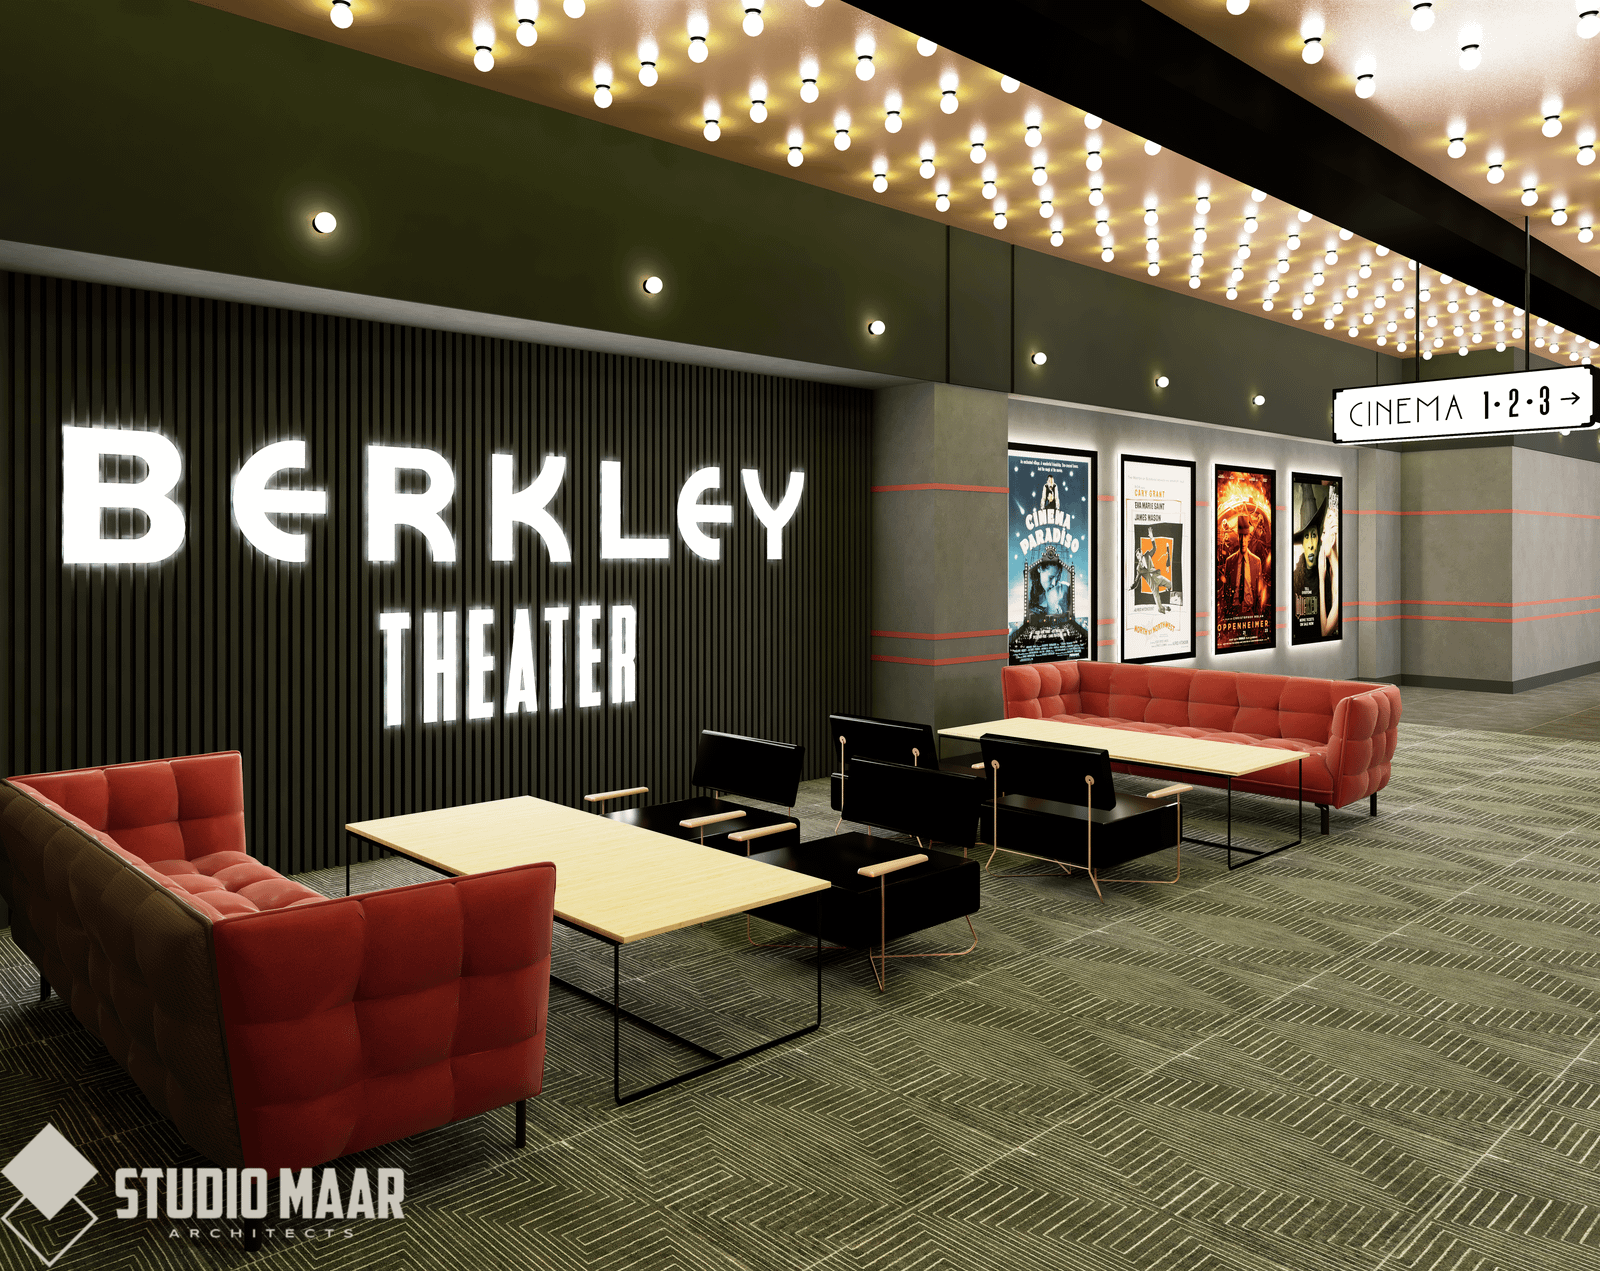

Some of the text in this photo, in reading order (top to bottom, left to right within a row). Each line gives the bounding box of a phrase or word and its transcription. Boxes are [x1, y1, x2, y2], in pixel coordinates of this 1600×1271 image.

[1350, 394, 1463, 427] CINEMA
[63, 425, 805, 564] BERKLEY
[1149, 490, 1165, 498] GRANT
[1025, 507, 1071, 530] CINEMA
[1020, 527, 1079, 556] PARADISO
[1217, 620, 1269, 631] OPPENHEIMER
[380, 604, 637, 727] THEATER
